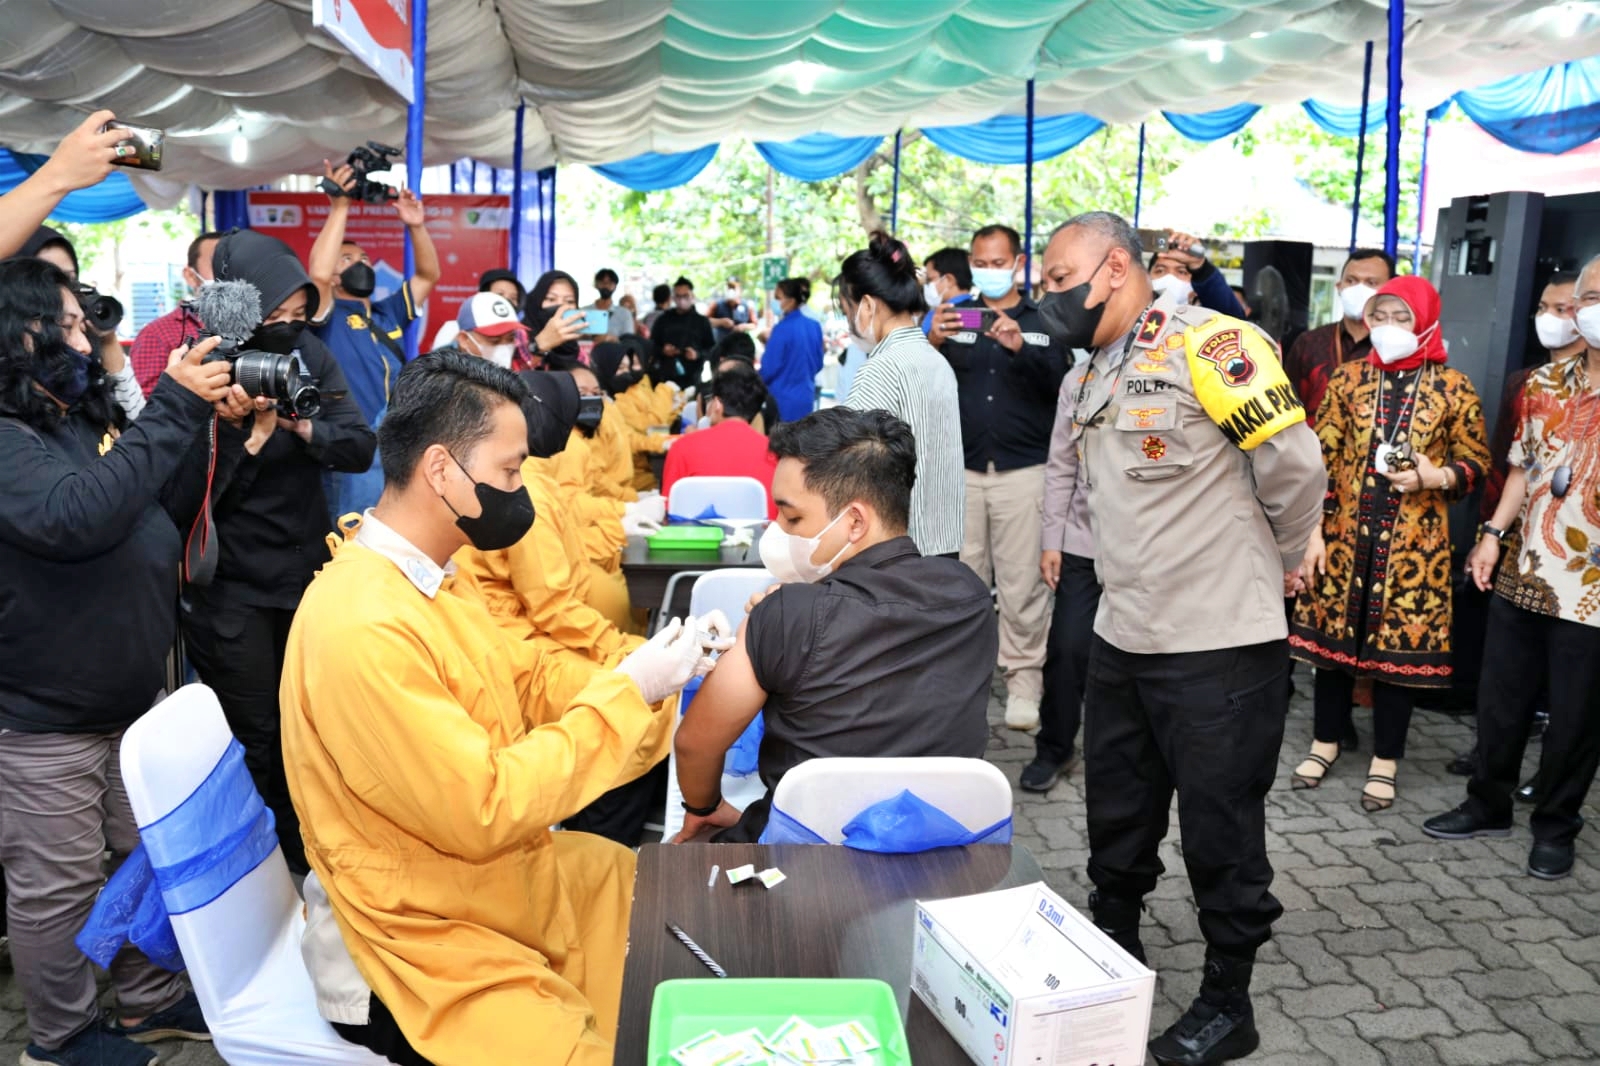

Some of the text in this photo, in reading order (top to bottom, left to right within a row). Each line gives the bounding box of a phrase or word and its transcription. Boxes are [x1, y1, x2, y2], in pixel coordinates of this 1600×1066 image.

[1204, 332, 1237, 354] POLDA
[1218, 396, 1274, 446] WAKIL
[1038, 898, 1065, 927] 0.3ml
[1043, 973, 1061, 991] 100
